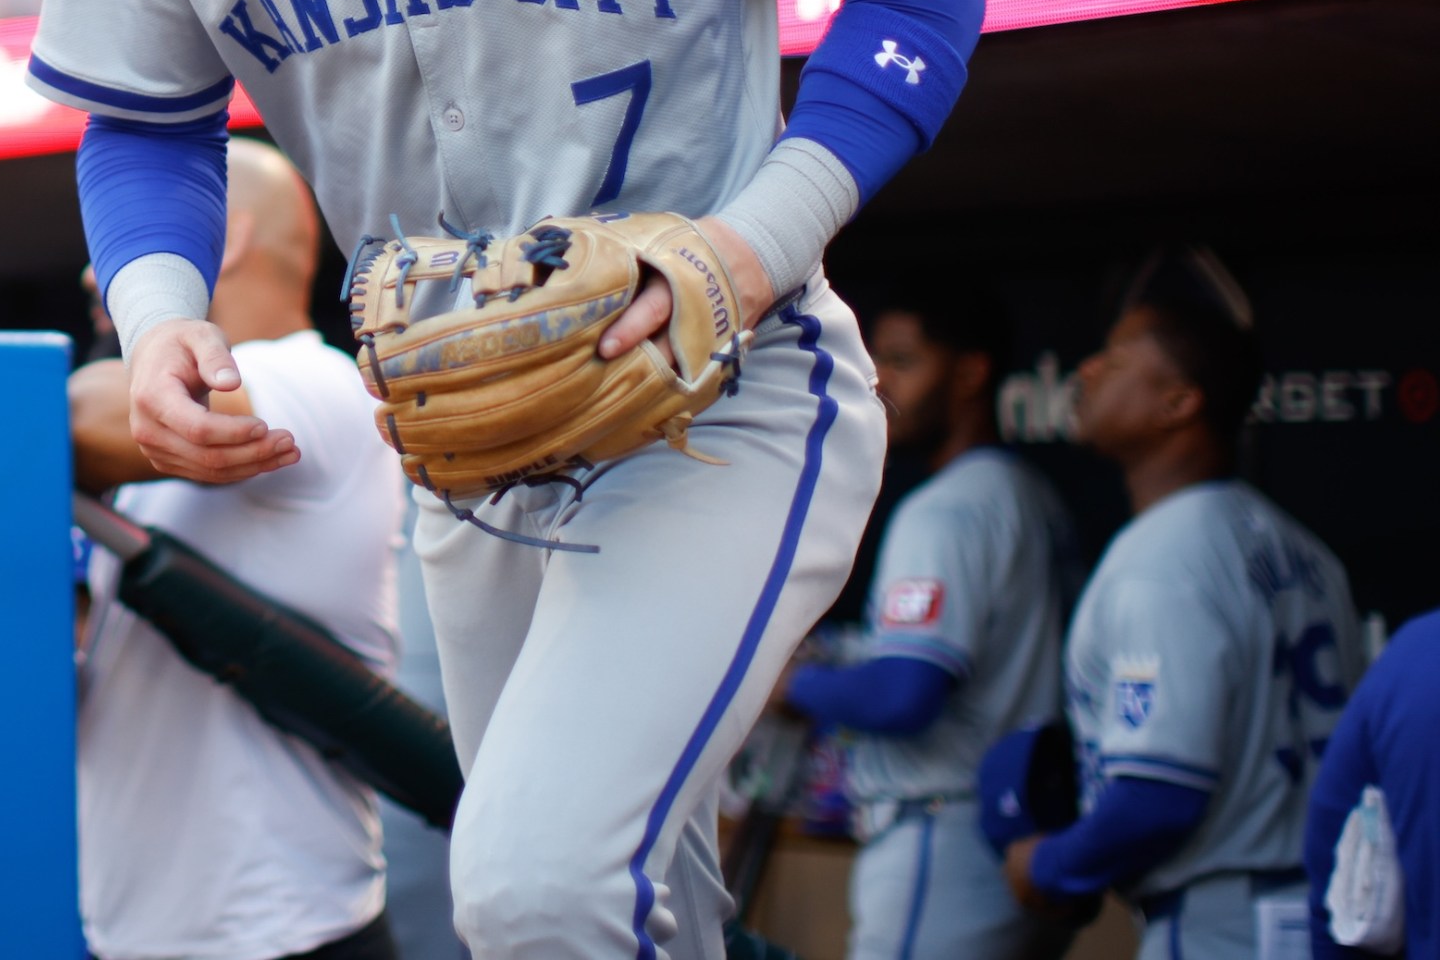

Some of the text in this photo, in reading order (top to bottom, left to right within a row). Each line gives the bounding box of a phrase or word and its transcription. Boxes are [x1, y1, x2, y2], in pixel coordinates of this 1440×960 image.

[570, 58, 653, 208] 7
[678, 247, 730, 339] Wilson
[484, 453, 559, 486] SIMPLE
